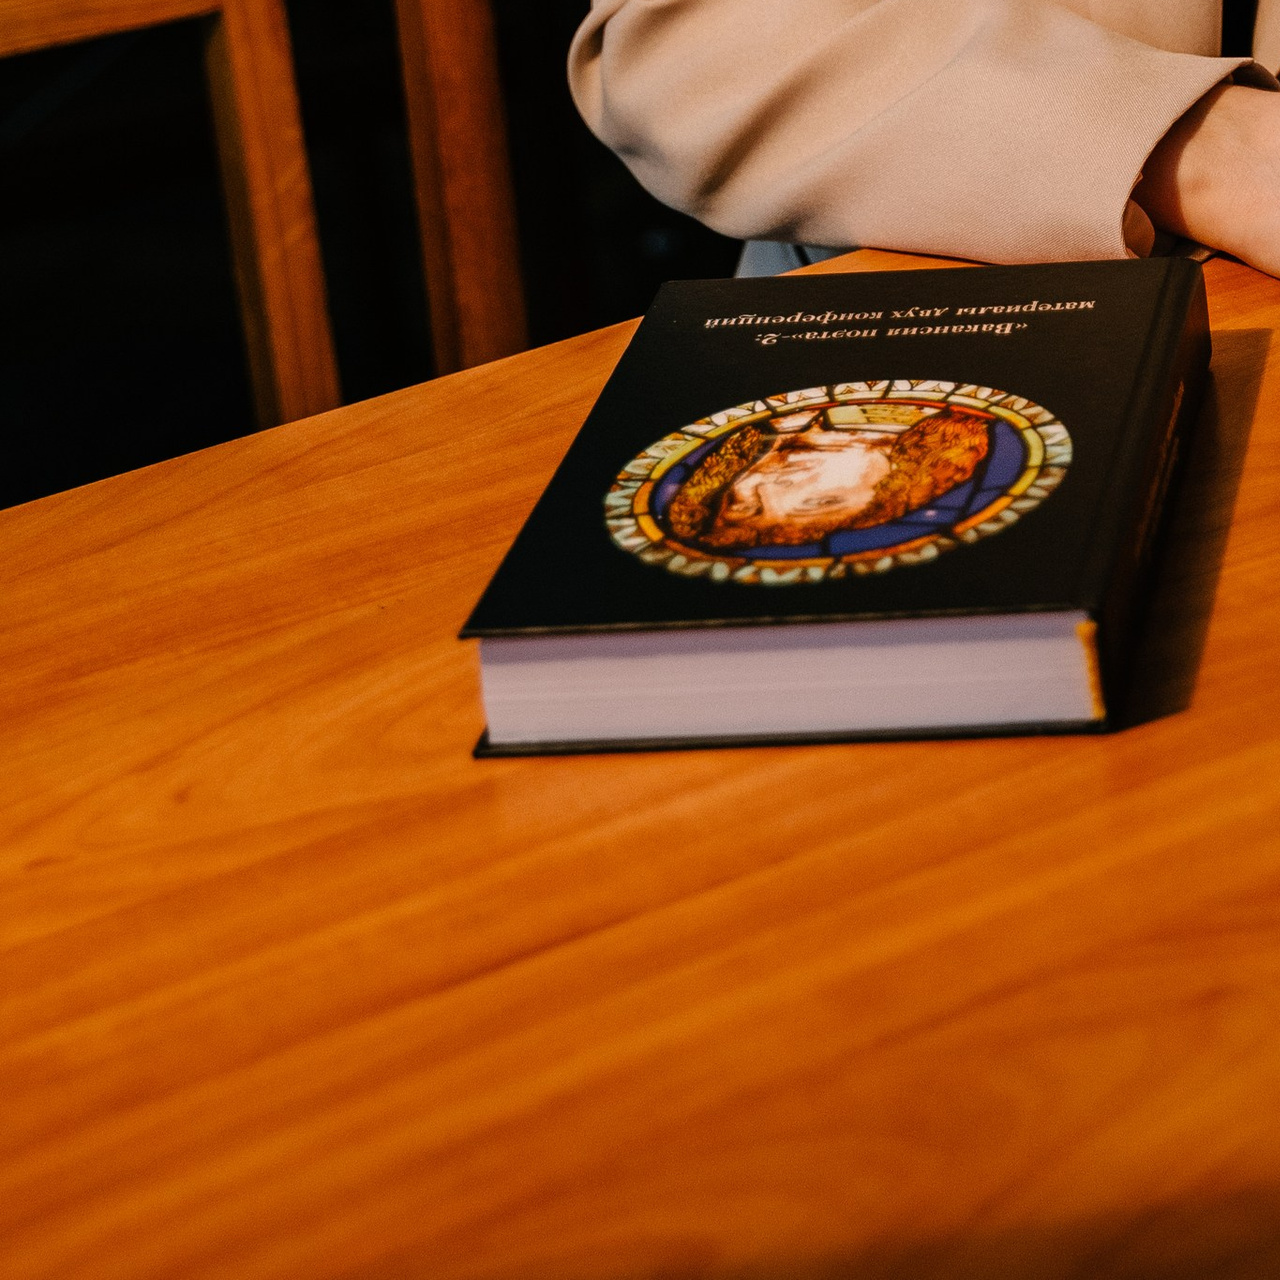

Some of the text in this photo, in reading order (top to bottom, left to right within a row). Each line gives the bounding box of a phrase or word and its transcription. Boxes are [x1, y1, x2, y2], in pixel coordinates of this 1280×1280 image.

[704, 300, 1096, 329] материалы двух конференций
[886, 321, 1029, 337] «Вакансия
